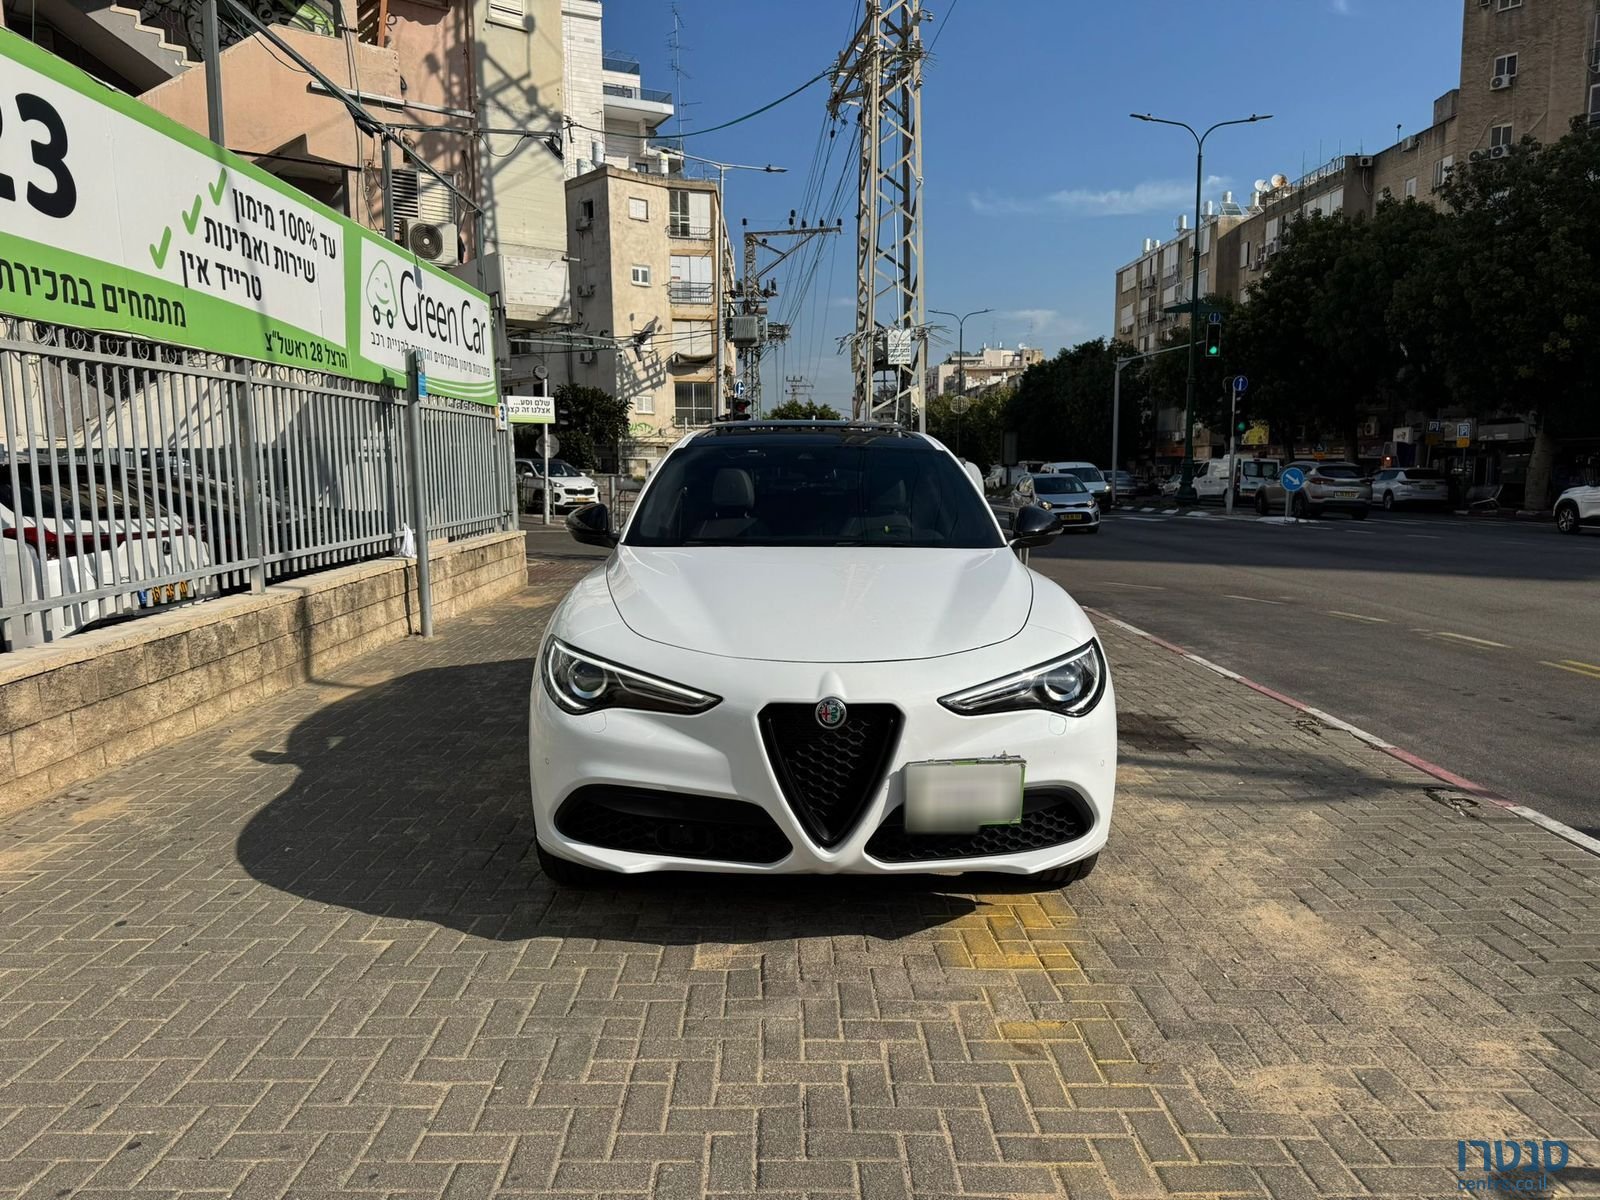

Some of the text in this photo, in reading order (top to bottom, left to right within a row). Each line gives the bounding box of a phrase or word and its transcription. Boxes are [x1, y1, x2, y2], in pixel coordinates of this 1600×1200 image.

[232, 188, 336, 260] עד 100% מימון
[203, 216, 316, 284] שירות ואמינות
[179, 250, 263, 301] טרייד אין
[101, 283, 187, 328] מתמחים
[400, 270, 486, 356] Green Car
[309, 341, 324, 363] 28
[324, 344, 348, 369] הרצל
[370, 331, 386, 347] רכב
